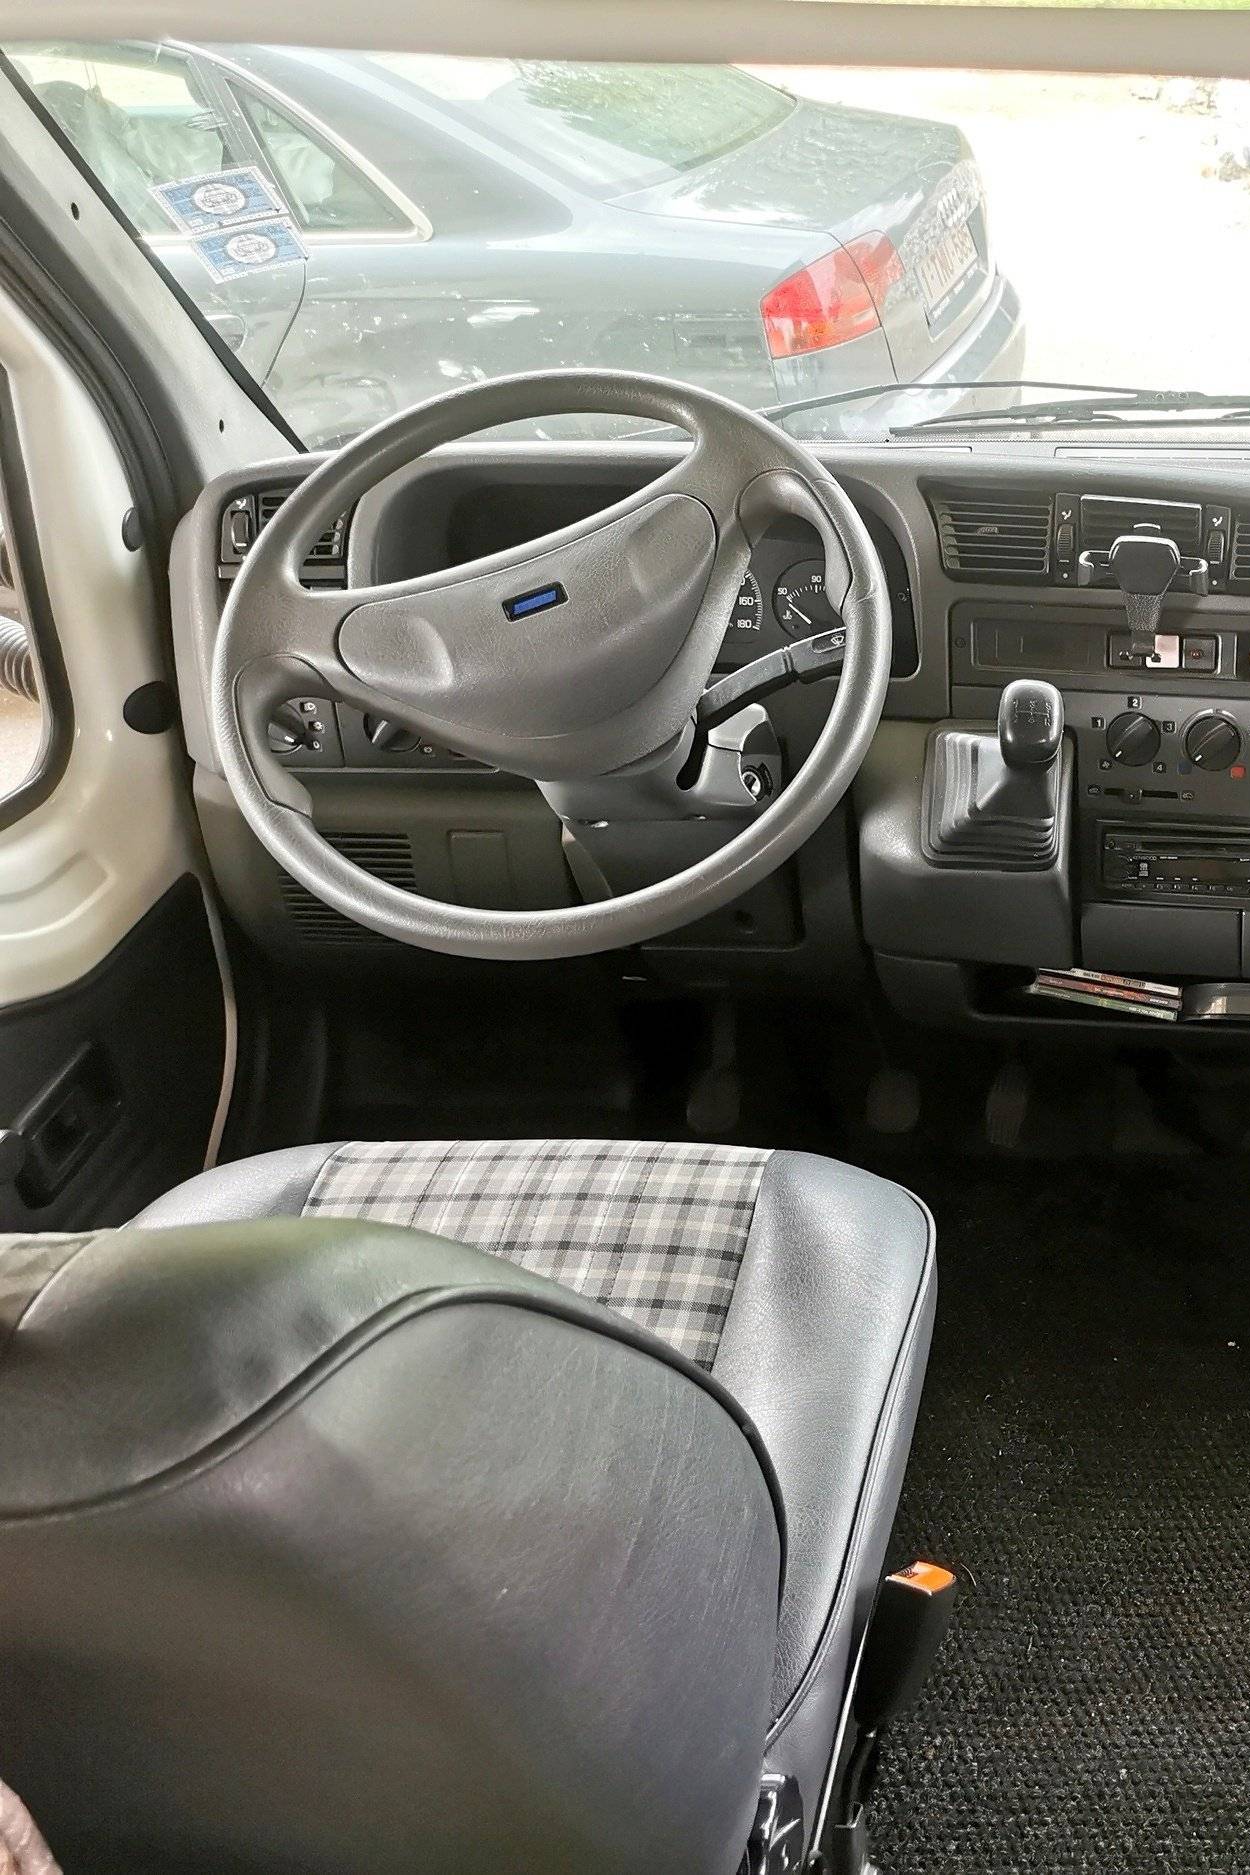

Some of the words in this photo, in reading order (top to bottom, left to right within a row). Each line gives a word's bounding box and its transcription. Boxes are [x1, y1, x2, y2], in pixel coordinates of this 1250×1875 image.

[811, 575, 822, 583] 90
[777, 587, 788, 595] 50
[738, 596, 754, 606] 160
[737, 619, 752, 629] 180
